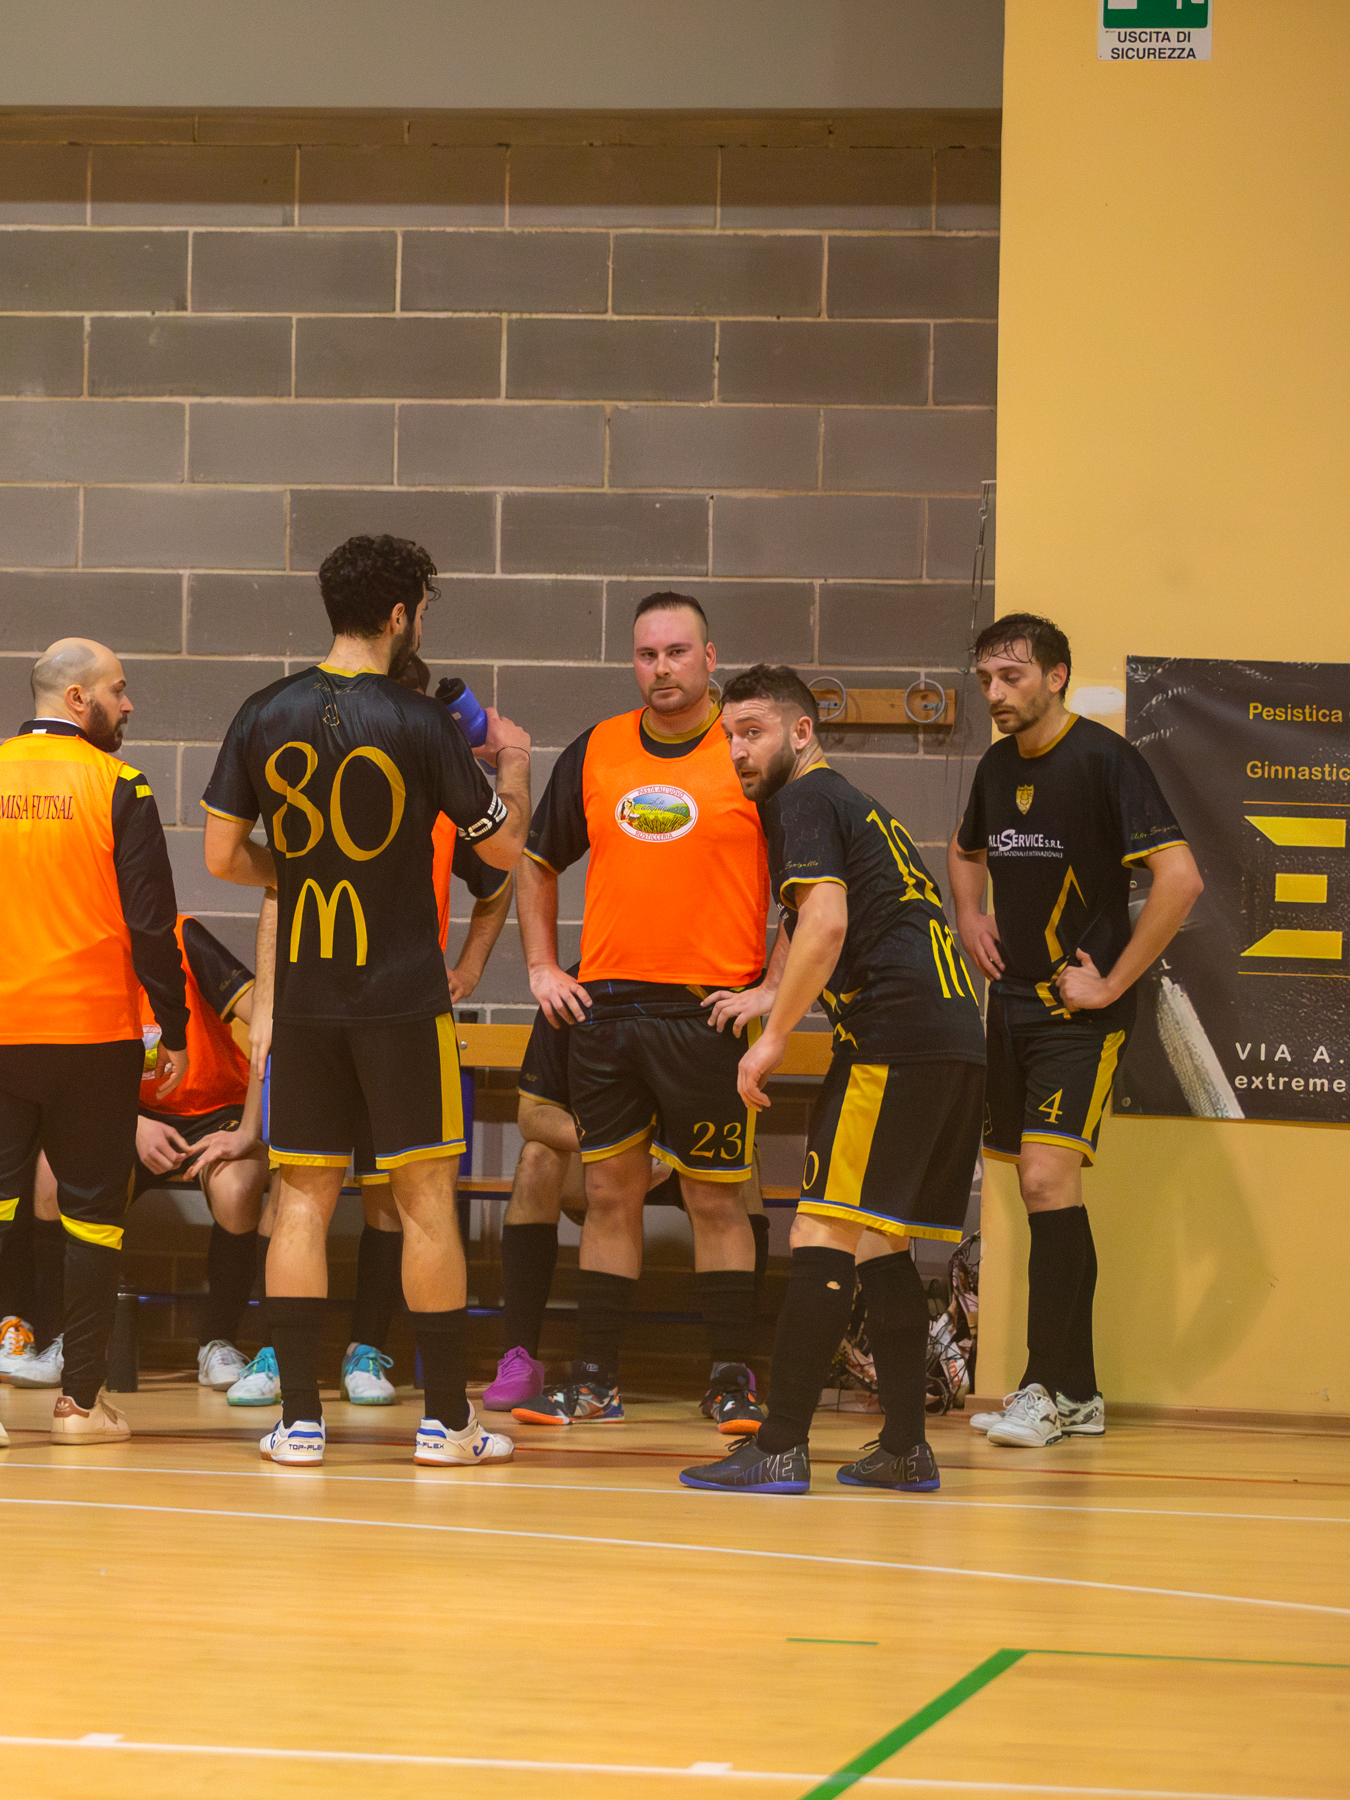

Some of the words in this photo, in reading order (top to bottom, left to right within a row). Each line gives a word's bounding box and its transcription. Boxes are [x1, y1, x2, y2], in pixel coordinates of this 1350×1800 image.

[1117, 31, 1171, 43] USCITA
[1176, 31, 1191, 43] DI
[1110, 47, 1196, 60] SICUREZZA
[1249, 702, 1343, 722] Pesistica
[1246, 760, 1350, 781] Ginnastic
[32, 795, 74, 820] FUTSAL
[265, 741, 406, 862] 80
[1235, 1042, 1292, 1061] VIA
[1313, 1045, 1344, 1064] A.
[1234, 1072, 1347, 1093] extreme
[1038, 1088, 1063, 1124] 4
[690, 1121, 742, 1160] 23
[288, 1443, 323, 1451] TOP-FLE
